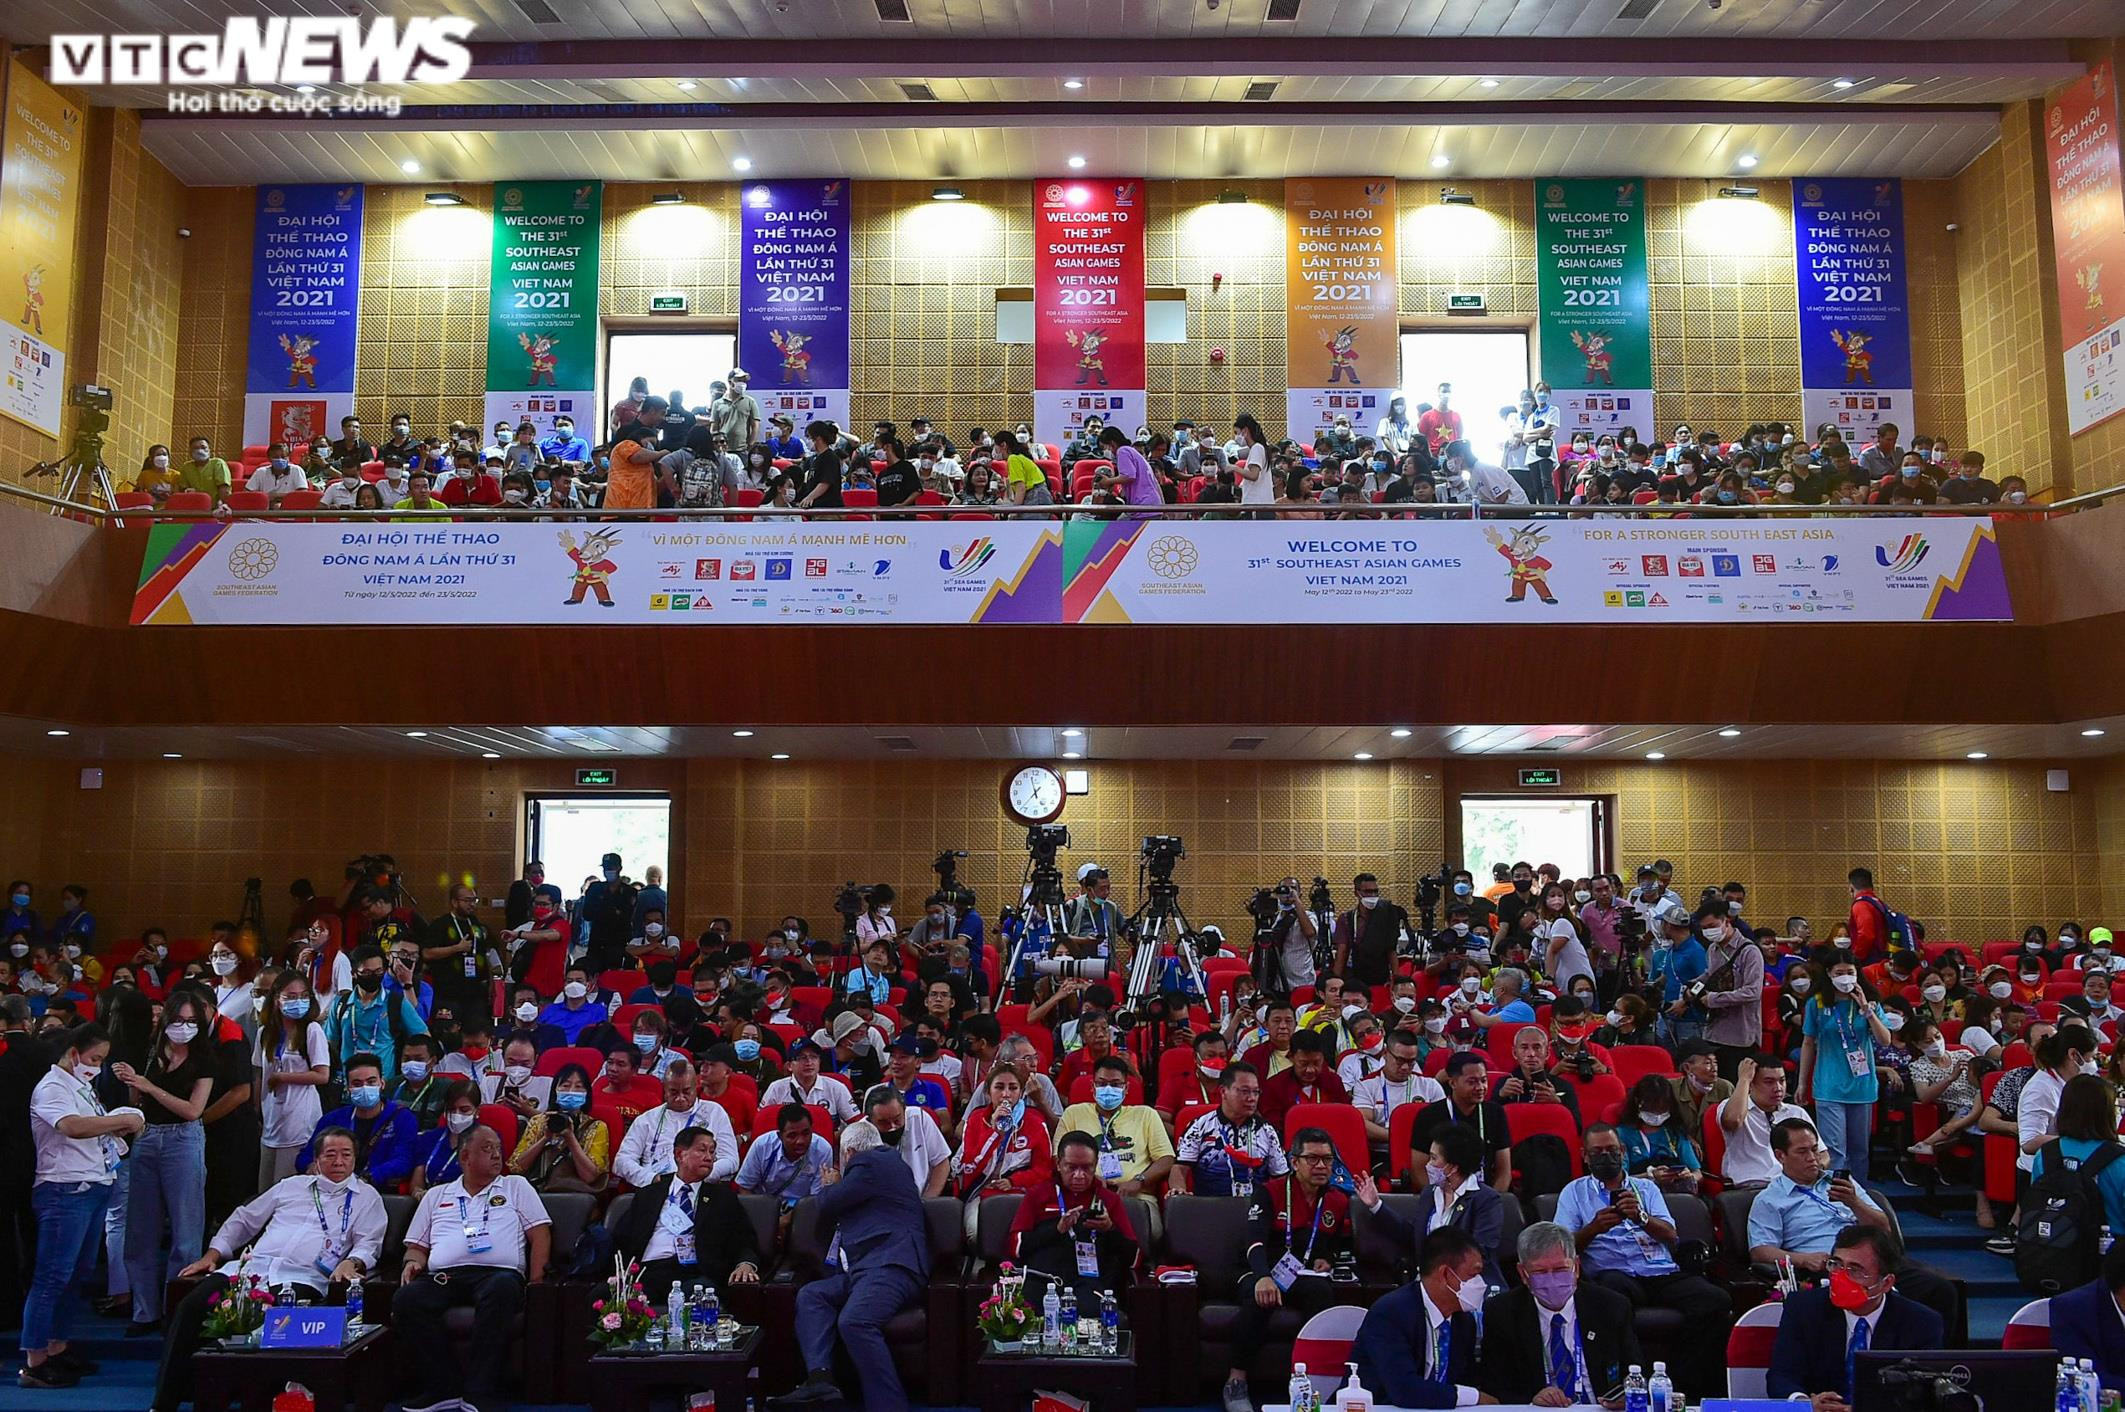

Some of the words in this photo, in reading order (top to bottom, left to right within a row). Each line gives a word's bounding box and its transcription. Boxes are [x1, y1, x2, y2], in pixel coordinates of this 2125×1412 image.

[16, 103, 58, 143] WELCOME
[60, 135, 70, 151] TO
[2060, 125, 2079, 146] ĐẠI
[2081, 107, 2100, 130] HỘI
[2055, 144, 2076, 170] THỂ
[2077, 123, 2108, 151] THAO
[277, 216, 306, 228] ĐẠI
[311, 214, 340, 228] HỘI
[504, 216, 566, 226] WELCOME
[568, 216, 584, 225] TO
[764, 212, 793, 224] ĐẠI
[798, 209, 828, 222] HỘI
[1047, 212, 1108, 222] WELCOME
[1112, 212, 1128, 222] TO
[1309, 210, 1338, 222] ĐẠI
[1344, 208, 1372, 222] HỘI
[1548, 213, 1610, 222] WELCOME
[1612, 212, 1630, 222] TO
[1817, 211, 1846, 223] ĐẠI
[1851, 209, 1880, 222] HỘI
[267, 229, 299, 243] THỂ
[302, 232, 348, 242] THAO
[754, 225, 786, 238] THỂ
[790, 228, 837, 238] THAO
[1063, 228, 1088, 238] THE
[1299, 224, 1332, 236] THỂ
[1336, 226, 1382, 236] THAO
[1564, 229, 1590, 238] THE
[1808, 225, 1840, 238] THỂ
[1844, 228, 1890, 238] THAO
[520, 232, 545, 242] THE
[265, 247, 303, 258] ĐÔNG
[306, 248, 335, 258] NAM
[338, 246, 348, 258] Á
[753, 242, 792, 254] ĐÔNG
[795, 244, 824, 254] NAM
[828, 241, 838, 253] Á
[1049, 244, 1126, 254] SOUTHEAST
[1298, 240, 1336, 252] ĐÔNG
[1374, 241, 1384, 252] Á
[1551, 244, 1628, 254] SOUTHEAST
[1808, 242, 1846, 254] ĐÔNG
[1850, 244, 1880, 253] NAM
[1882, 242, 1892, 254] Á
[506, 247, 581, 258] SOUTHEAST
[300, 262, 328, 273] THỨ
[331, 263, 344, 272] 31
[510, 261, 540, 271] ASIAN
[542, 261, 575, 270] GAMES
[788, 257, 818, 268] THỨ
[820, 259, 834, 268] 31
[1086, 258, 1120, 268] GAMES
[1334, 256, 1364, 267] THỨ
[1367, 258, 1380, 267] 31
[1558, 258, 1586, 268] ASIAN
[1589, 258, 1623, 268] GAMES
[1844, 257, 1874, 268] THỨ
[1877, 259, 1890, 268] 31
[267, 275, 303, 289] VIỆT
[307, 277, 344, 286] NAM
[756, 271, 792, 285] VIỆT
[797, 272, 834, 282] NAM
[1302, 269, 1338, 284] VIỆT
[1560, 276, 1588, 286] VIET
[1592, 276, 1621, 286] NAM
[1812, 270, 1849, 284] VIỆT
[1854, 272, 1892, 282] NAM
[512, 278, 540, 288] VIET
[543, 278, 572, 288] NAM
[276, 290, 334, 306] 2021
[766, 286, 824, 302] 2021
[1060, 289, 1116, 304] 2021
[1312, 284, 1371, 300] 2021
[1563, 290, 1620, 306] 2021
[1824, 286, 1882, 302] 2021
[514, 292, 570, 308] 2021
[342, 533, 372, 547] ĐẠI
[377, 530, 408, 548] HỘI
[414, 530, 448, 544] THỂ
[452, 534, 500, 544] THAO
[653, 534, 666, 545] VÌ
[670, 534, 702, 547] MỘT
[706, 534, 746, 545] ĐÔNG
[752, 535, 784, 545] NAM
[788, 532, 798, 544] Á
[802, 535, 844, 547] MẠNH
[850, 533, 870, 544] MẼ
[874, 534, 906, 544] HƠN
[1584, 530, 1612, 540] FOR
[1630, 530, 1706, 540] STRONGER
[1710, 530, 1760, 540] SOUTH
[1764, 530, 1797, 540] EAST
[1802, 530, 1834, 540] ASIA
[1288, 540, 1387, 552] WELCOME
[1392, 540, 1418, 552] TO
[322, 553, 370, 566] ĐÔNG
[374, 555, 410, 566] NAM
[414, 552, 425, 566] Á
[465, 552, 499, 566] THỨ
[501, 555, 516, 565] 31
[1276, 559, 1360, 568] SOUTHEAST
[1364, 558, 1407, 568] ASIAN
[1411, 558, 1462, 568] GAMES
[364, 573, 395, 587] VIỆT
[398, 574, 432, 584] NAM
[435, 574, 465, 584] 2021
[1306, 576, 1337, 585] VIET
[302, 1322, 326, 1334] VIP
